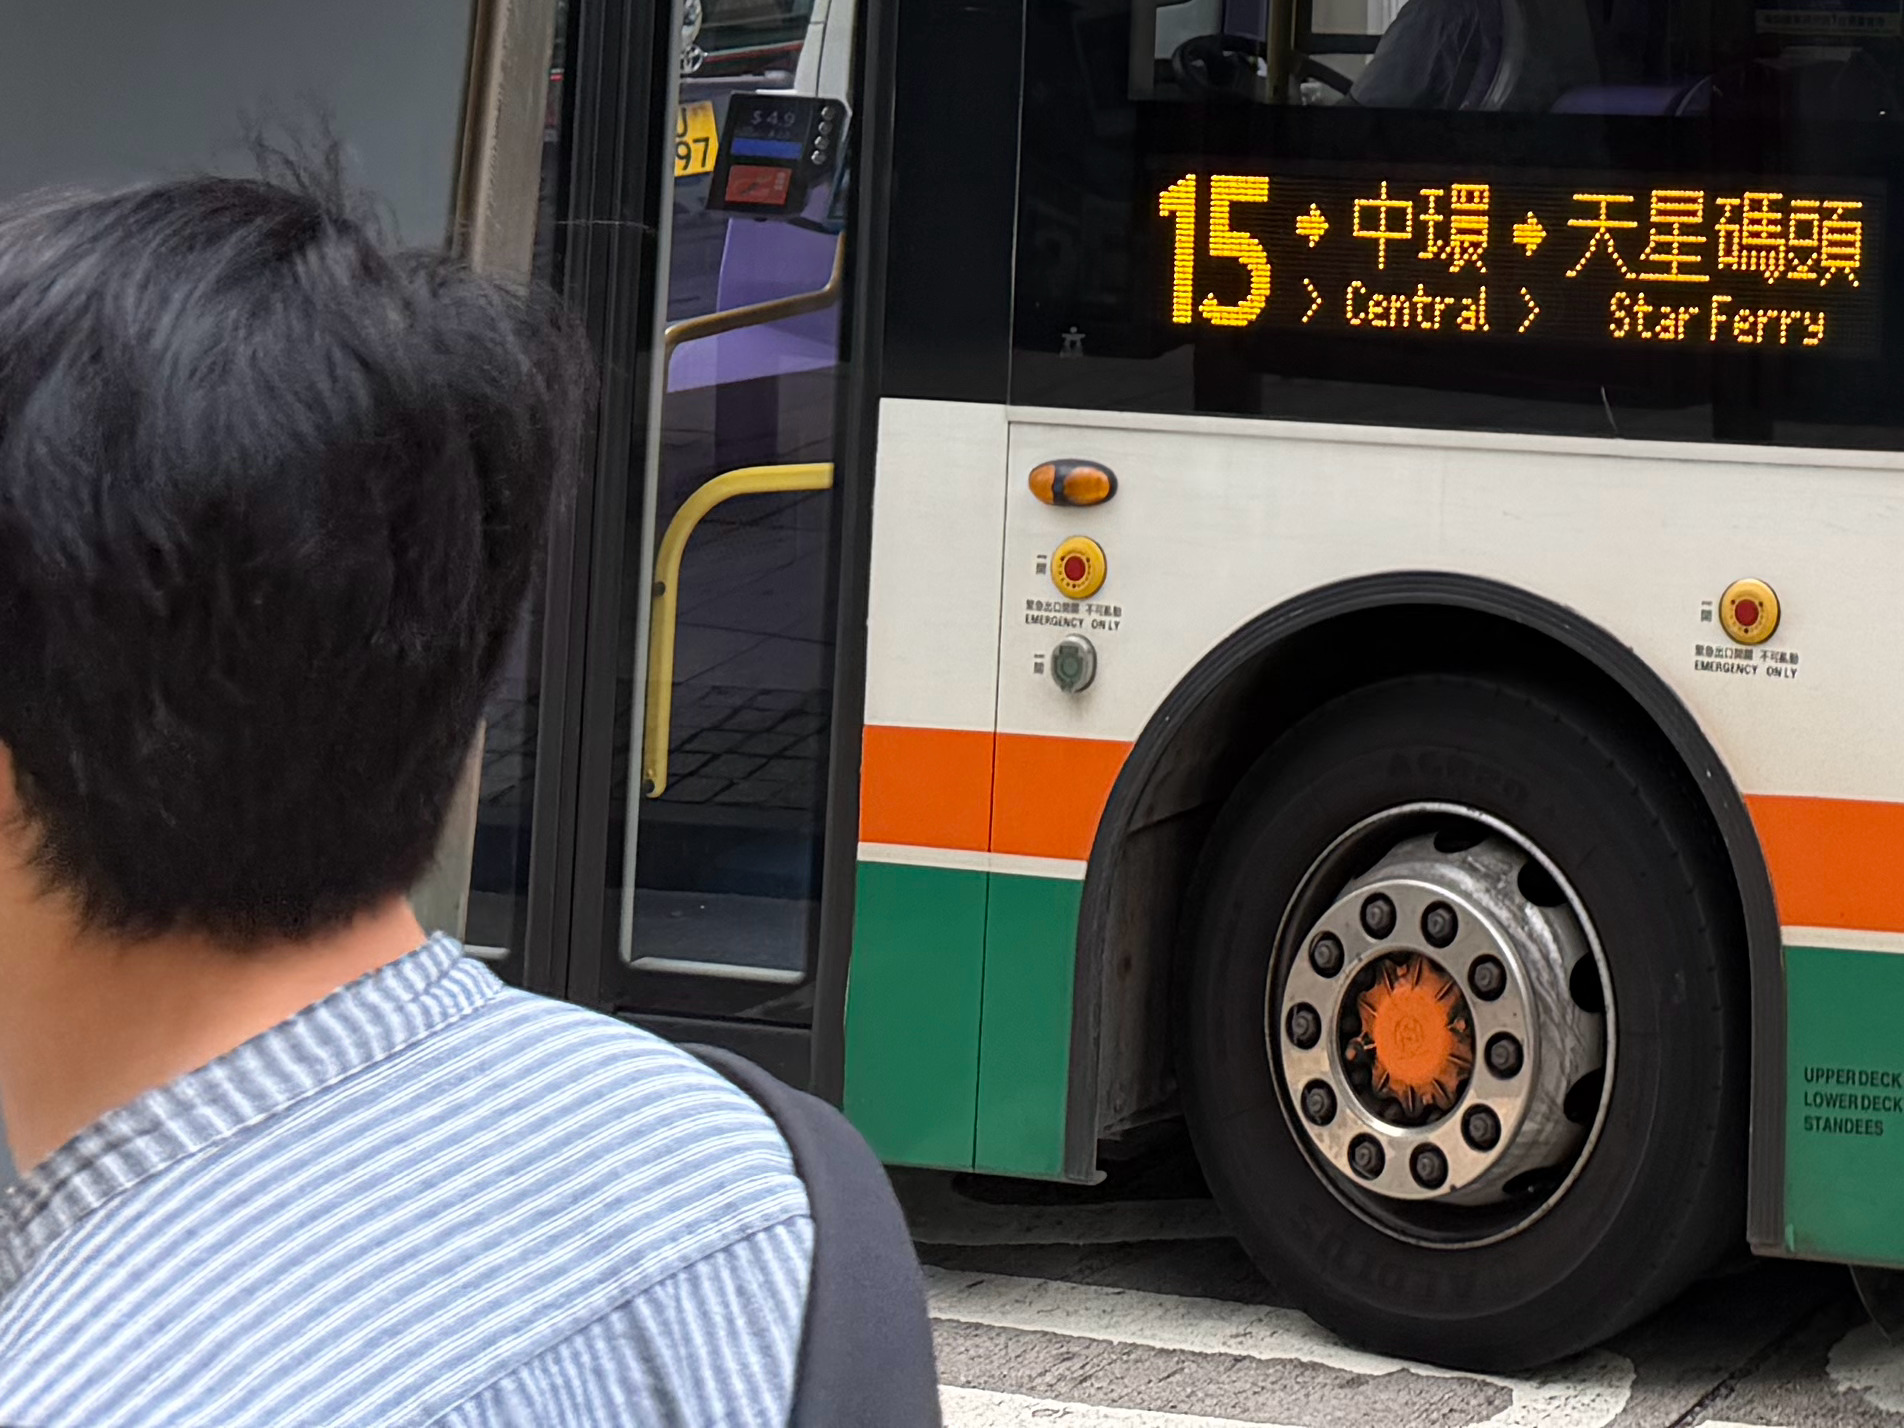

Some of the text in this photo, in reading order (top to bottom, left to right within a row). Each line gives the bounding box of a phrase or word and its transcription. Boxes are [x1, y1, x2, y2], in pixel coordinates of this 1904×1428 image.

[1352, 180, 1863, 286] 中環 天星碼頭
[1159, 174, 1271, 326] 15
[1345, 282, 1825, 345] Central Star Ferry
[1025, 613, 1084, 629] EMERGENCY
[1694, 660, 1758, 675] EMERGENCY
[1804, 1066, 1856, 1086] UPPER
[1859, 1070, 1901, 1088] DECK
[1804, 1091, 1858, 1110] LOWER
[1861, 1095, 1902, 1113] DECK
[1804, 1115, 1884, 1137] STANDEES
